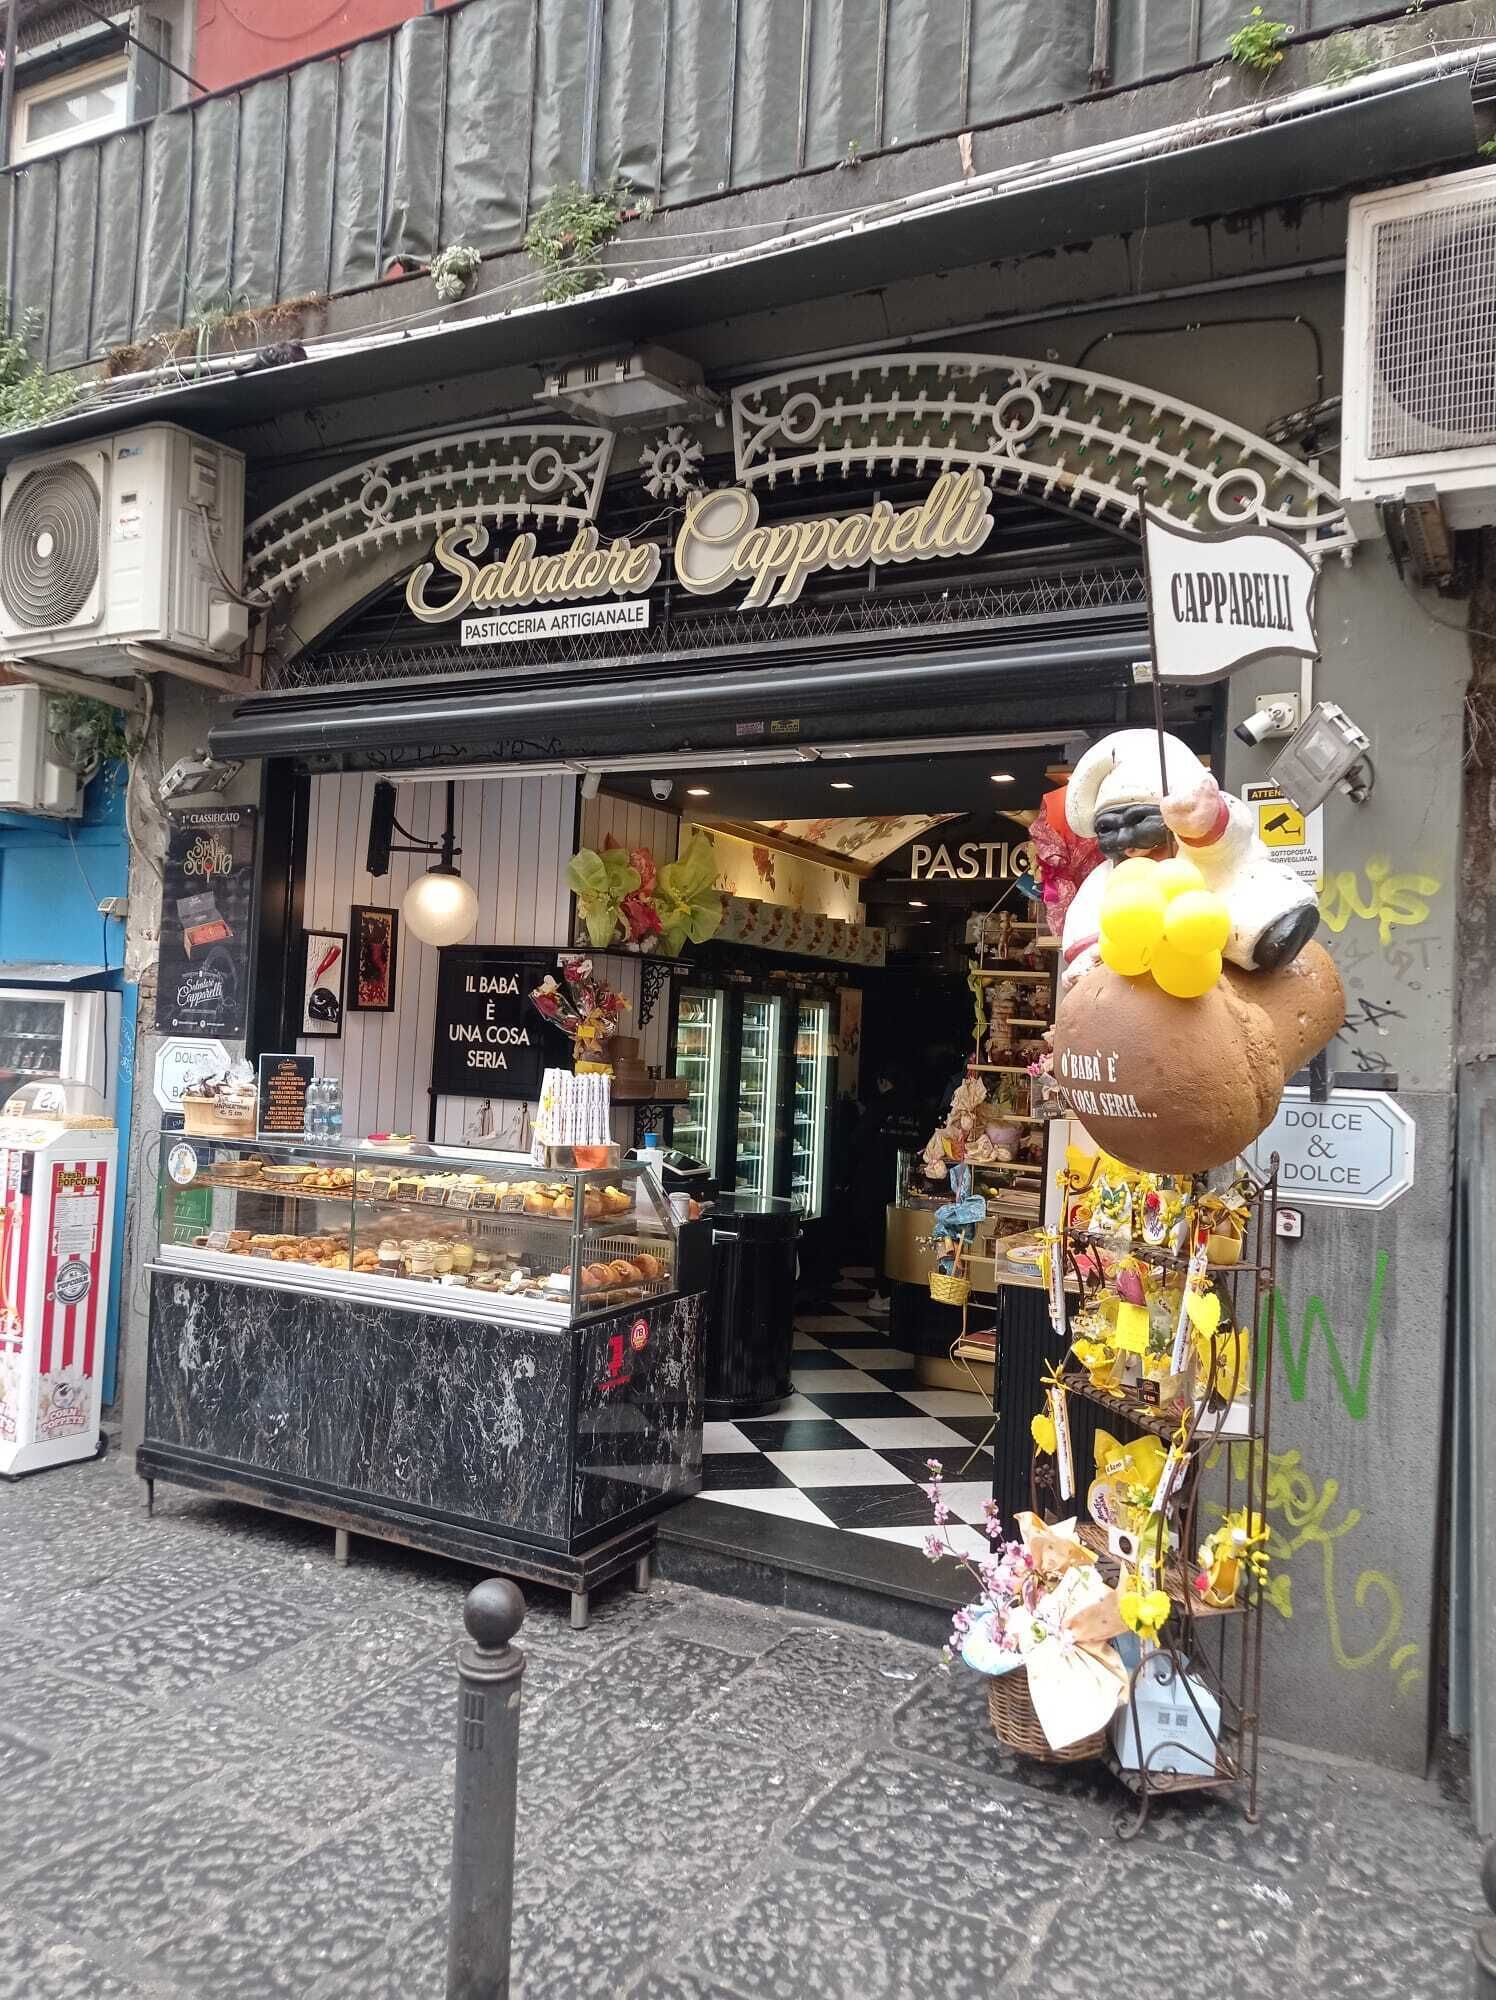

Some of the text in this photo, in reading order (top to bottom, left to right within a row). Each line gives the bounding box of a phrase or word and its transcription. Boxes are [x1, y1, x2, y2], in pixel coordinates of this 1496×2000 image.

[406, 470, 994, 622] Salvatore Capparelli
[1171, 571, 1294, 632] CAPPARELLI
[464, 606, 645, 640] PASTICCERIA ARTIGIANALE
[190, 812, 240, 824] CLASSIFICATO
[1270, 849, 1312, 857] SOTTOPOSTA
[465, 973, 520, 995] IL BABÀ
[486, 999, 496, 1020] È
[449, 1024, 530, 1046] UNA COSA
[467, 1050, 508, 1070] SERIA
[1071, 1088, 1101, 1115] COSA
[1285, 1110, 1362, 1131] DOLCE
[1307, 1134, 1338, 1159] &
[57, 1177, 100, 1187] POPCORN
[58, 1171, 82, 1179] Fresh
[1284, 1163, 1361, 1185] DOLCE
[50, 1408, 81, 1421] CORN
